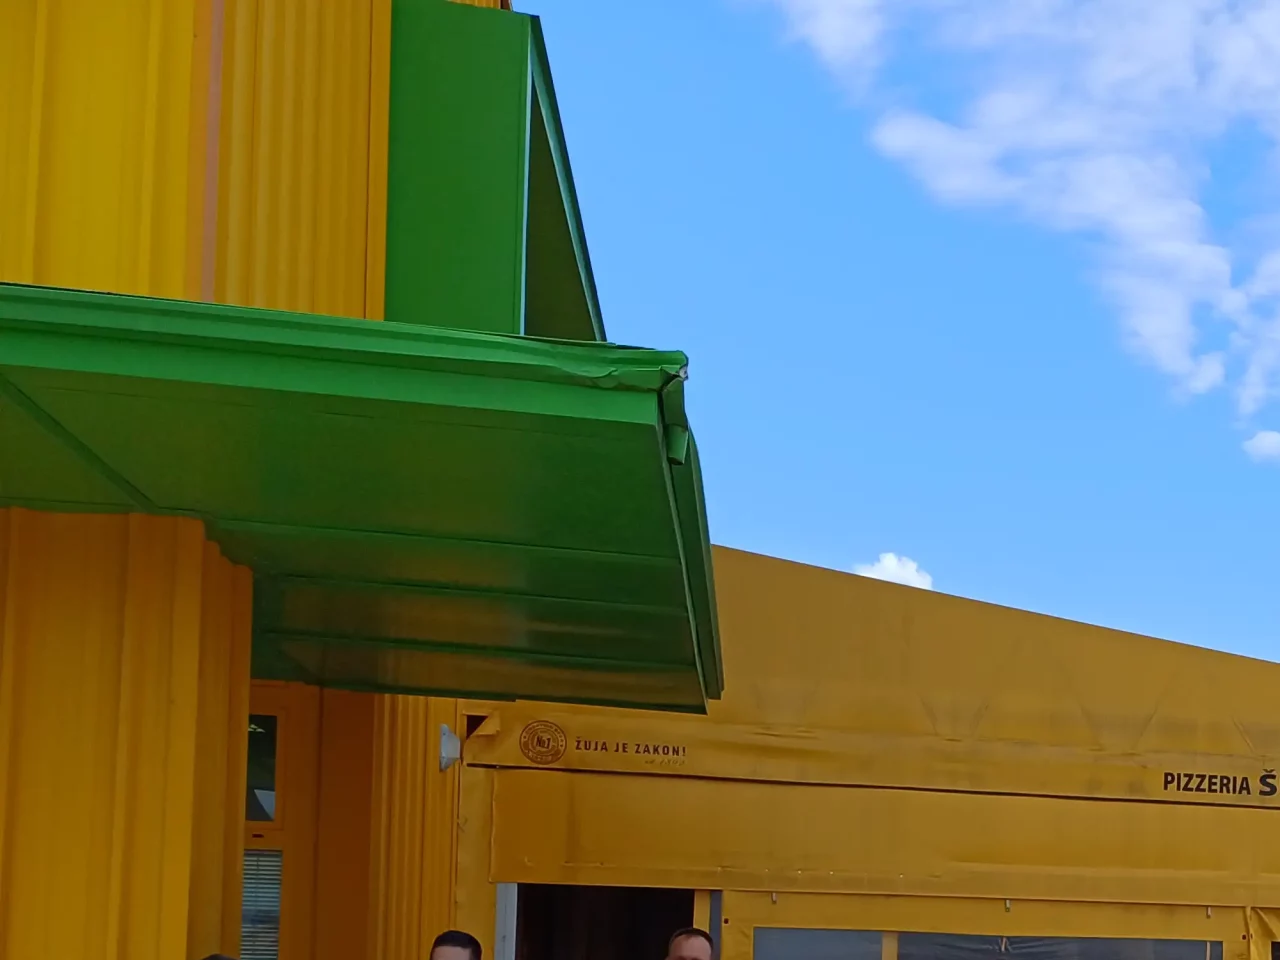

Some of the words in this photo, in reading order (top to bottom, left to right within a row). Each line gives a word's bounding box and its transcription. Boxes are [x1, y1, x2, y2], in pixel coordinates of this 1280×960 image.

[575, 736, 608, 752] ŽUJA
[614, 742, 629, 753] JE
[634, 743, 686, 757] ZAKON!
[1163, 772, 1251, 795] PIZZERIA
